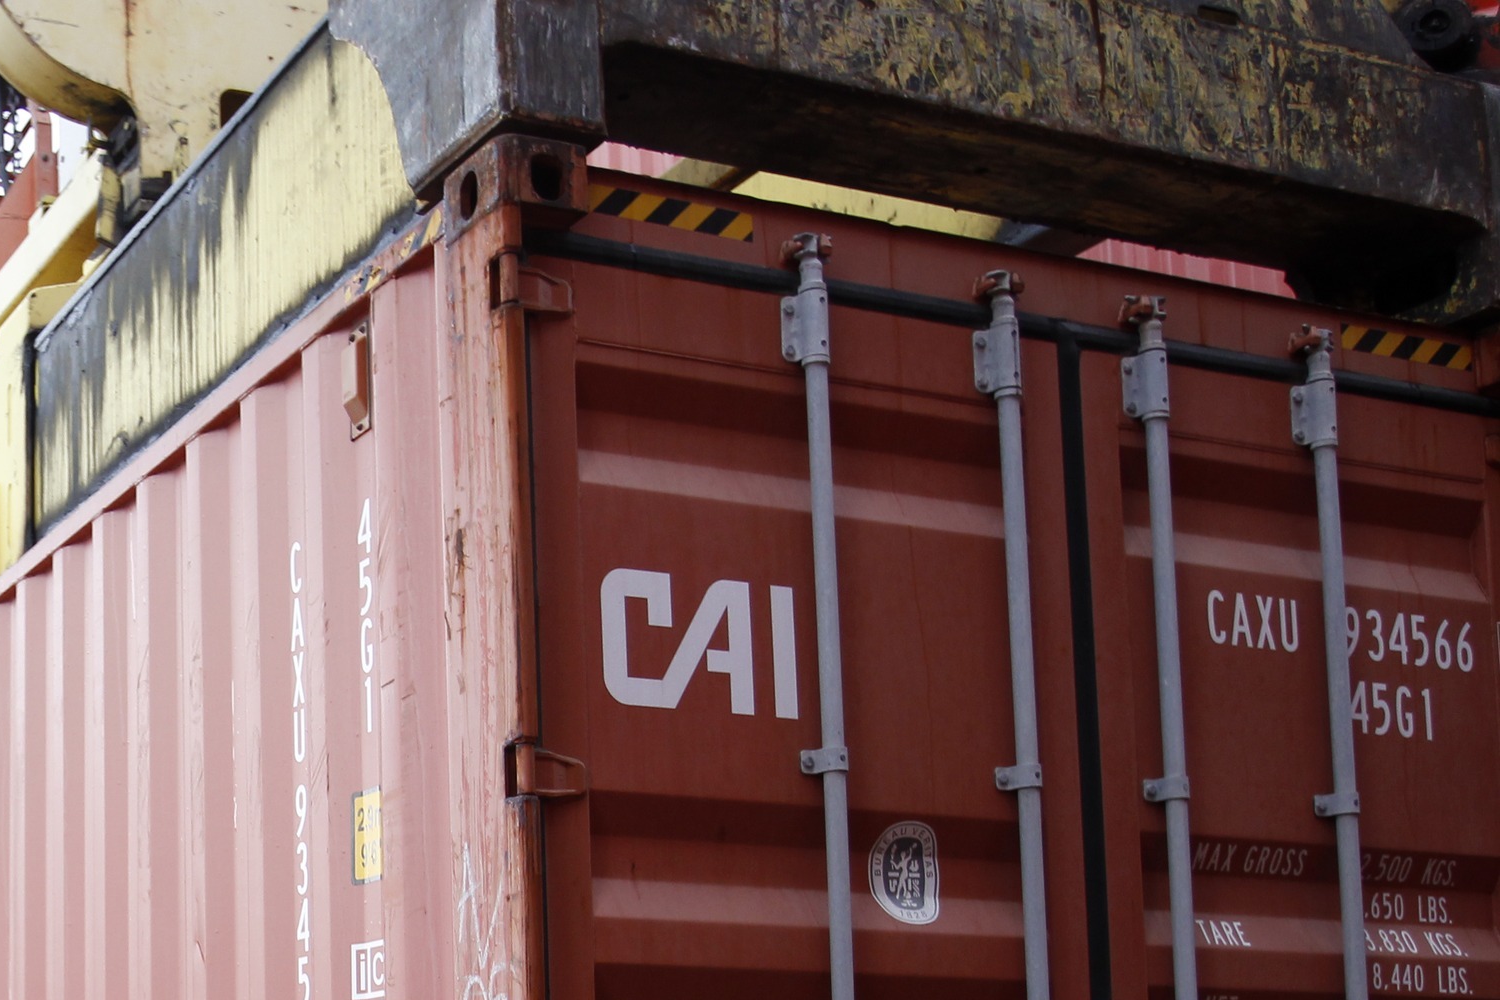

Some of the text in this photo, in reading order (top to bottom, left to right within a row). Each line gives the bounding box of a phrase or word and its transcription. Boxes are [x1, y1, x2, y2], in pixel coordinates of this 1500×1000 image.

[357, 497, 373, 733] 45G1
[1207, 589, 1474, 673] CAXU 934566
[290, 541, 305, 763] CAXU
[601, 568, 799, 720] CAI
[1351, 680, 1434, 741] 45G1
[1193, 841, 1308, 877] MAX GROSS
[1421, 858, 1457, 887] KGS.
[1417, 896, 1453, 924] LBS.
[1195, 919, 1251, 948] TARE
[1423, 931, 1469, 958] KGS.
[1438, 965, 1474, 995] LBS.
